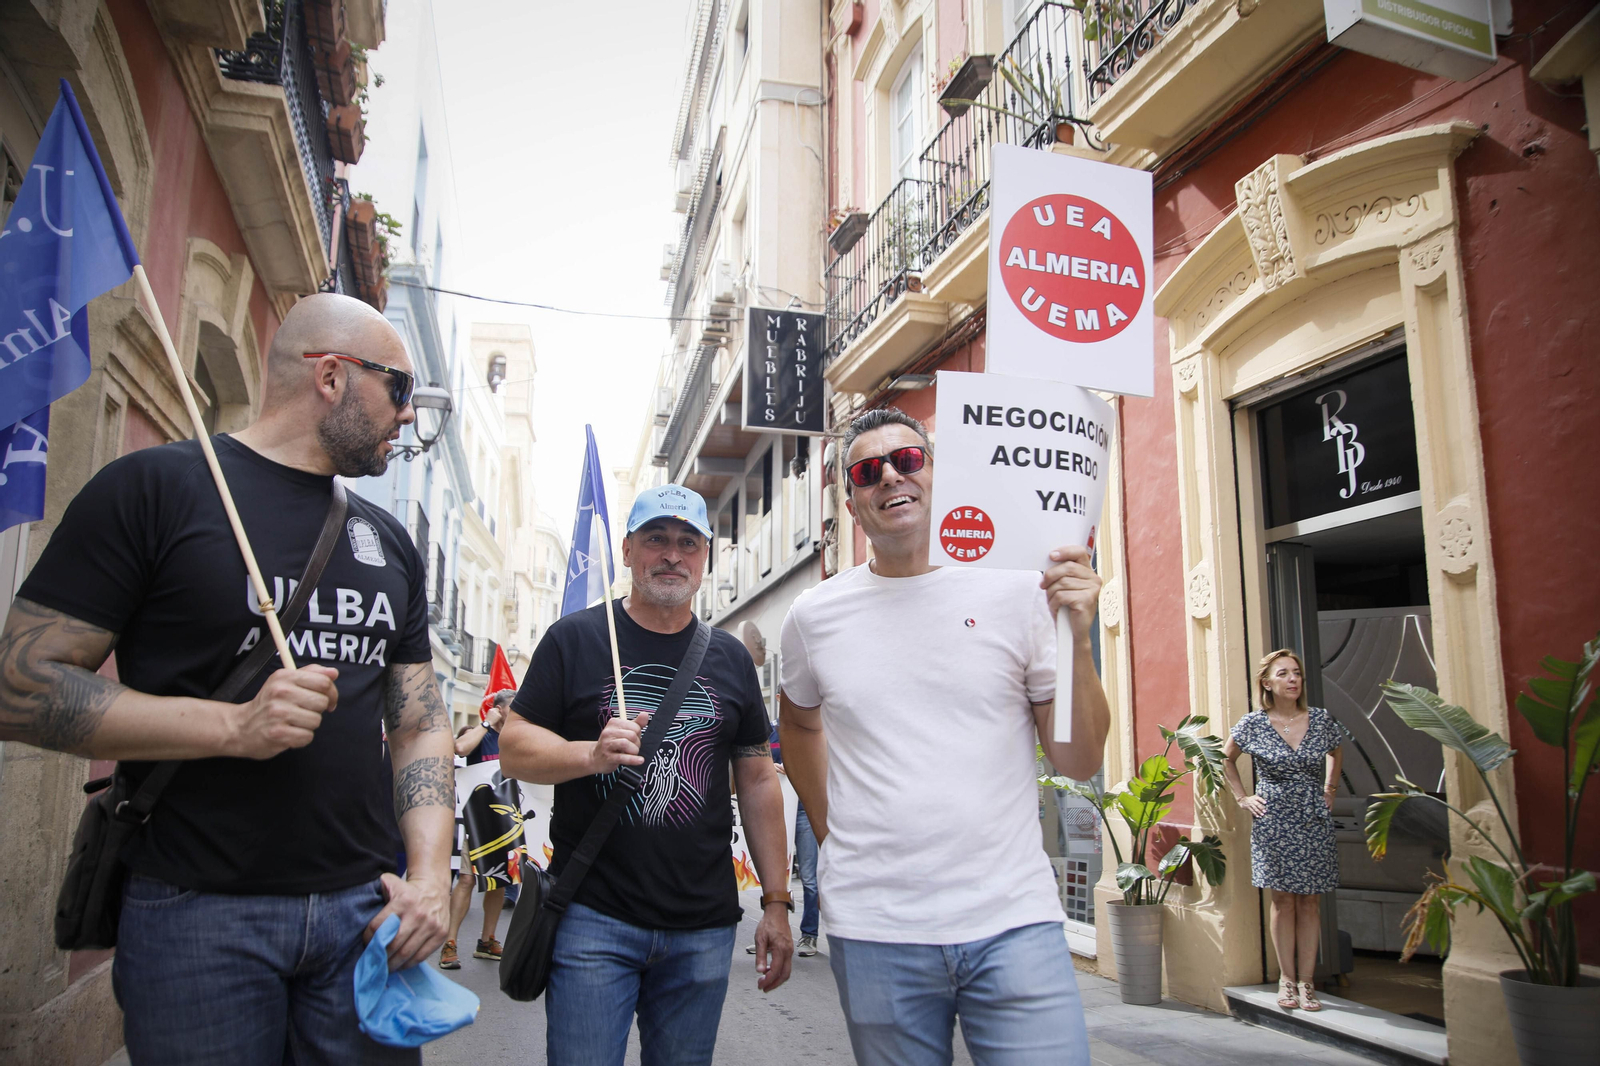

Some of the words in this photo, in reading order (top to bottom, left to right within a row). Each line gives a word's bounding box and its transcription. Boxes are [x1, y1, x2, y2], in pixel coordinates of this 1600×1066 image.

[1378, 0, 1441, 27] DISTRIBUIDOR
[1441, 19, 1476, 40] OFICIAL
[1032, 203, 1112, 241] UEA
[1005, 245, 1140, 289] ALMERIA
[1020, 286, 1129, 331] UEMA
[765, 315, 780, 422] MUEBLES
[795, 318, 807, 424] RABRIJU
[963, 404, 1109, 452] NEGOCIACIÓN
[990, 445, 1098, 481] ACUERDO
[657, 490, 687, 500] UPLBA
[1036, 489, 1086, 517] YA!!!
[1361, 479, 1384, 495] Desde
[941, 528, 993, 539] ALMERIA
[952, 509, 983, 522] UEA
[946, 543, 988, 558] UEMA
[235, 626, 387, 667] AMERIA
